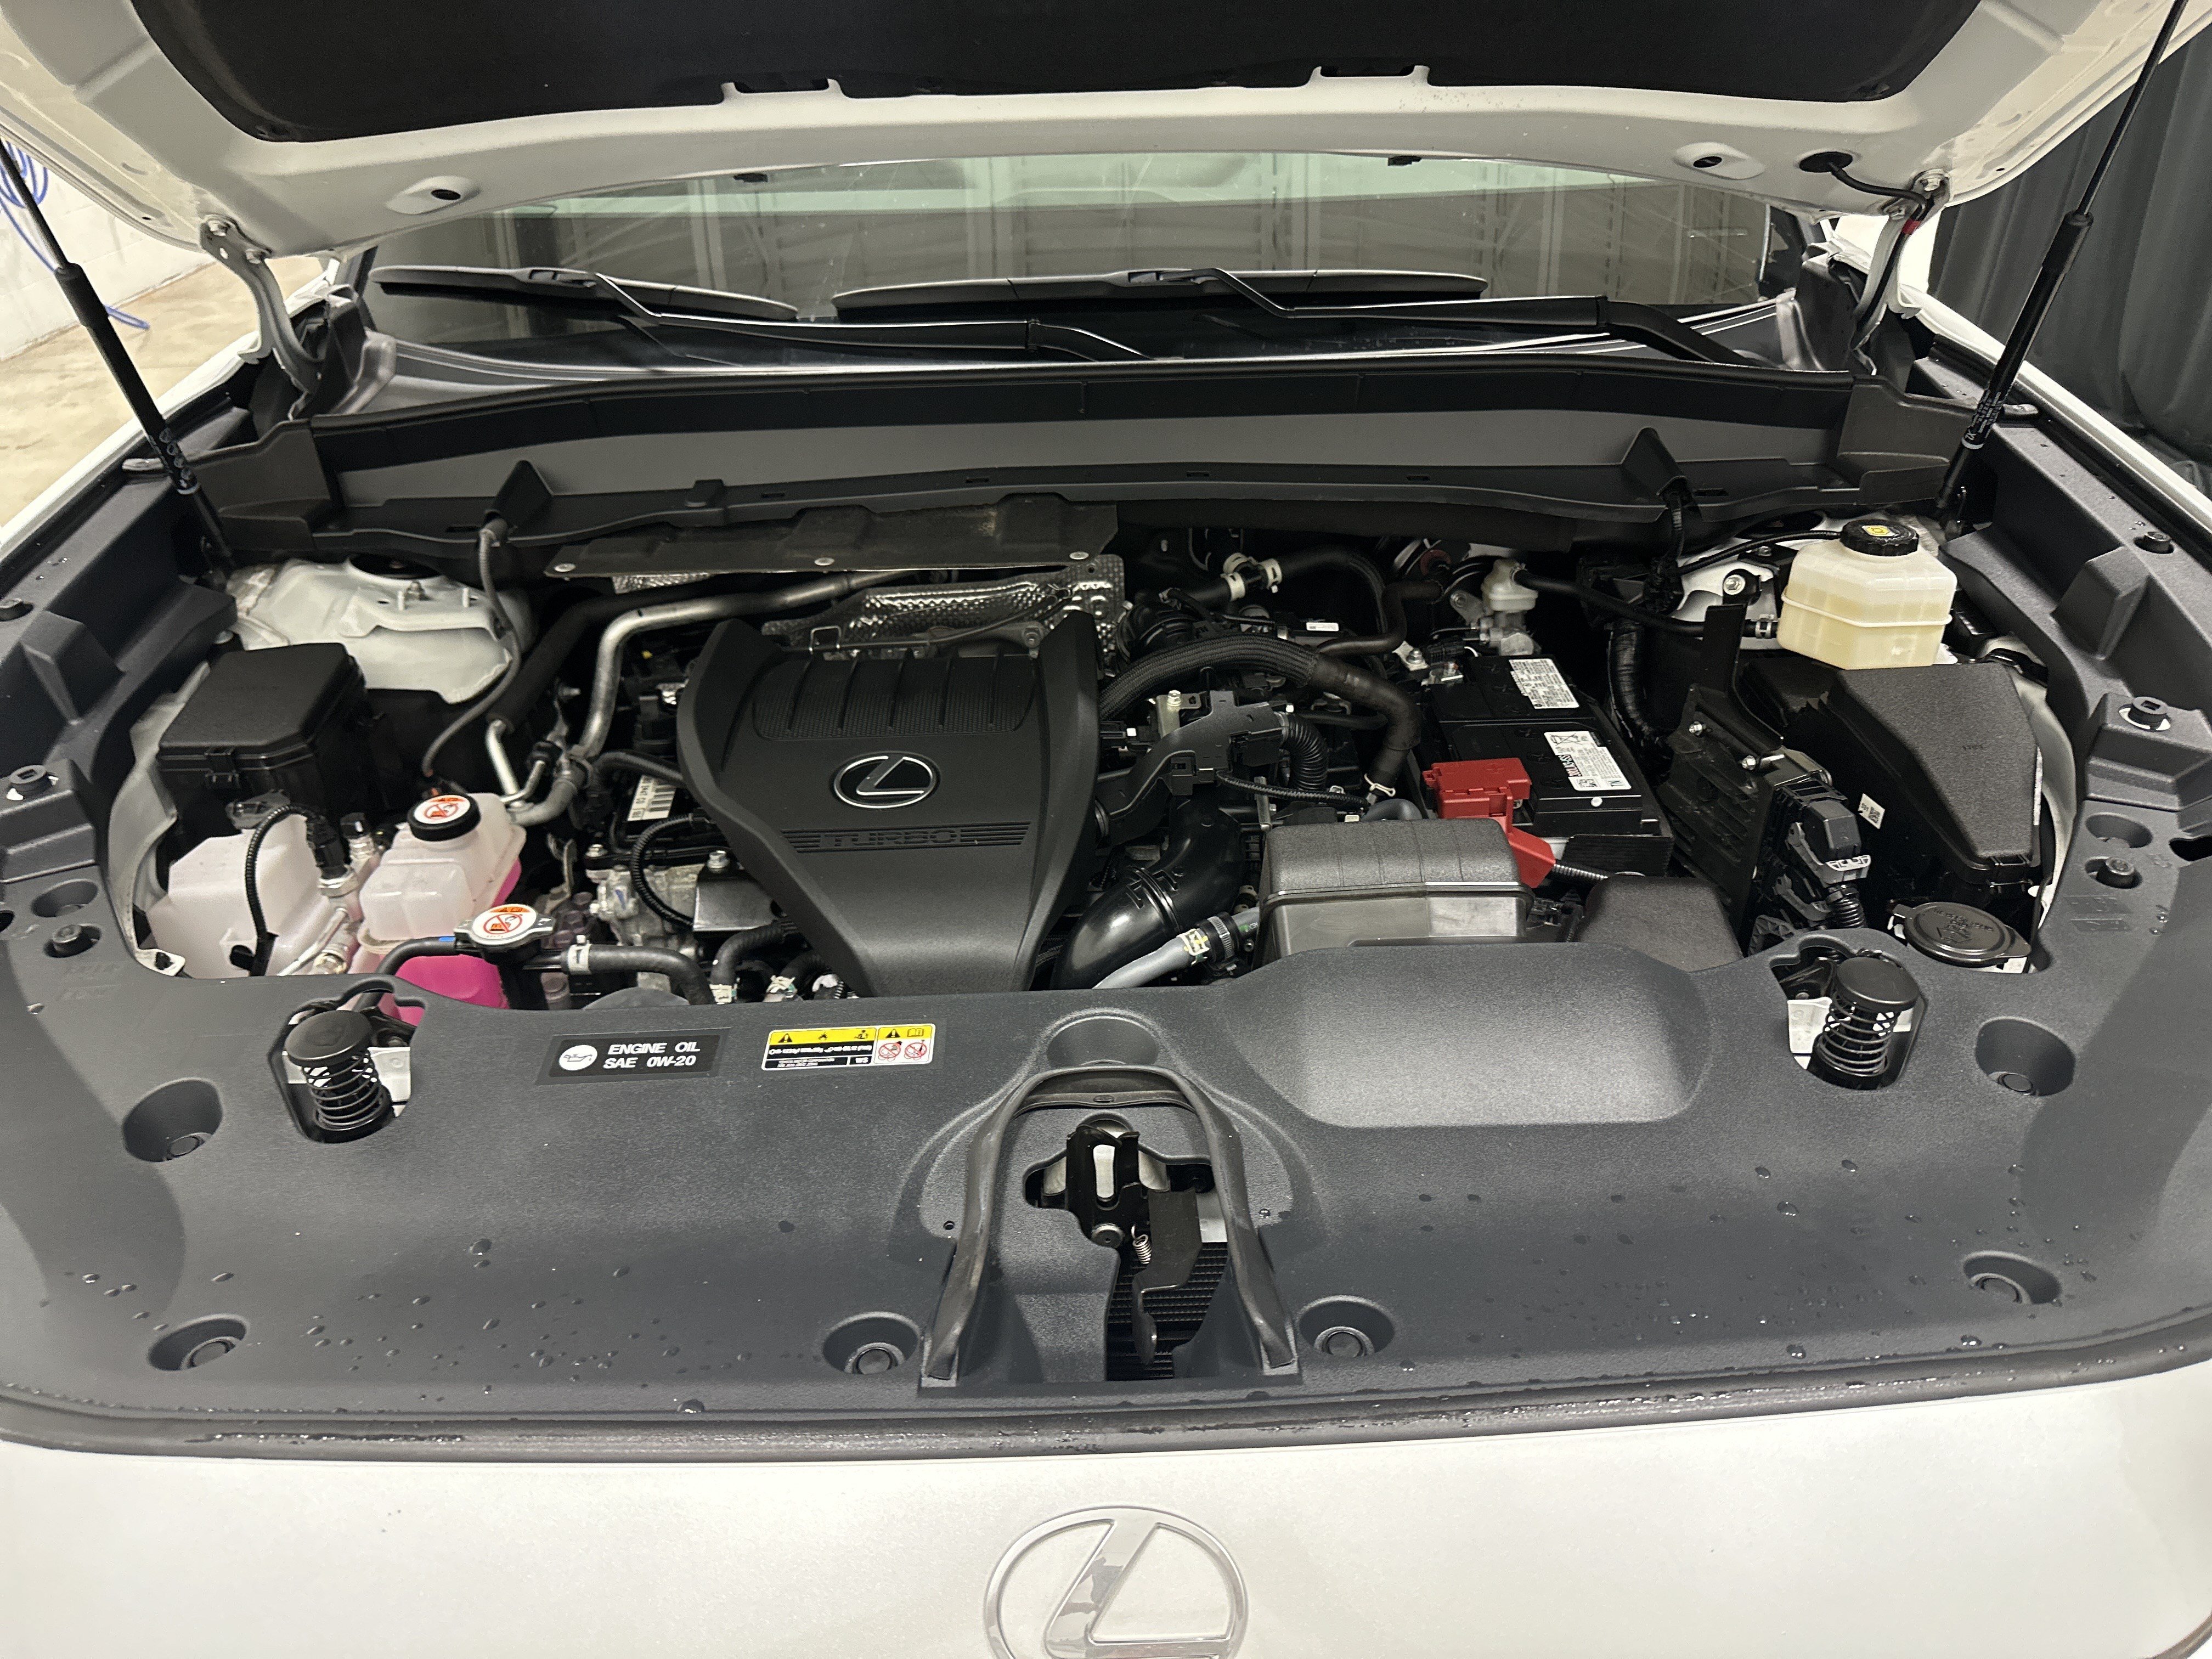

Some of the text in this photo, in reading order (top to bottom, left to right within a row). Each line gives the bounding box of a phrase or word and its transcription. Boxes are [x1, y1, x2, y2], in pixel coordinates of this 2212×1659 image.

[824, 829, 957, 847] TURBO
[607, 1041, 701, 1055] ENGINE OIL
[603, 1055, 697, 1069] SAE 0W-20
